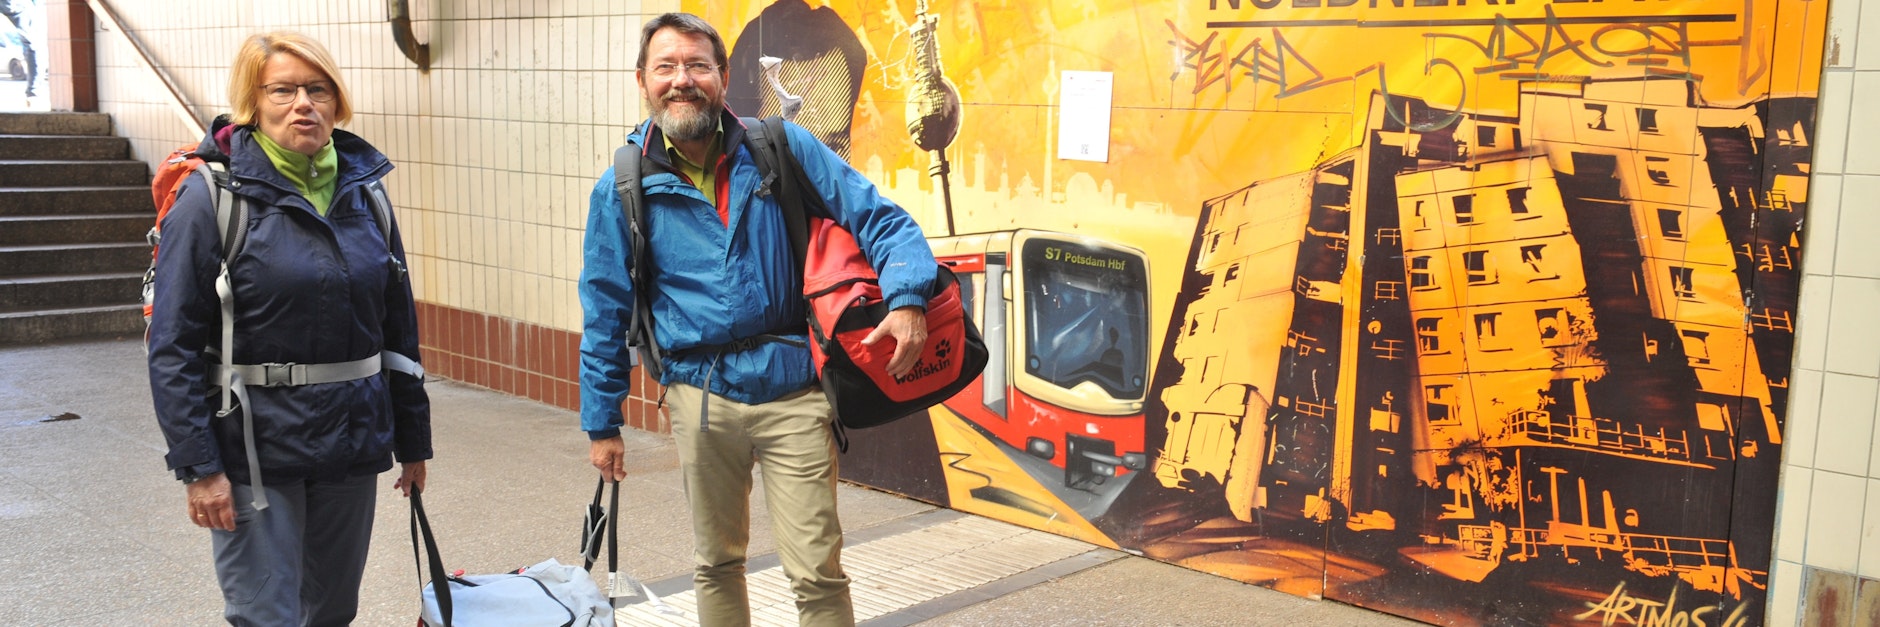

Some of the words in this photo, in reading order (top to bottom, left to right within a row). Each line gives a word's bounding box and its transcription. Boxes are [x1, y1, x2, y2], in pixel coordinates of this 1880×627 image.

[1045, 247, 1062, 260] S7
[1064, 252, 1106, 267] Potsdam
[1108, 258, 1126, 270] Hbf
